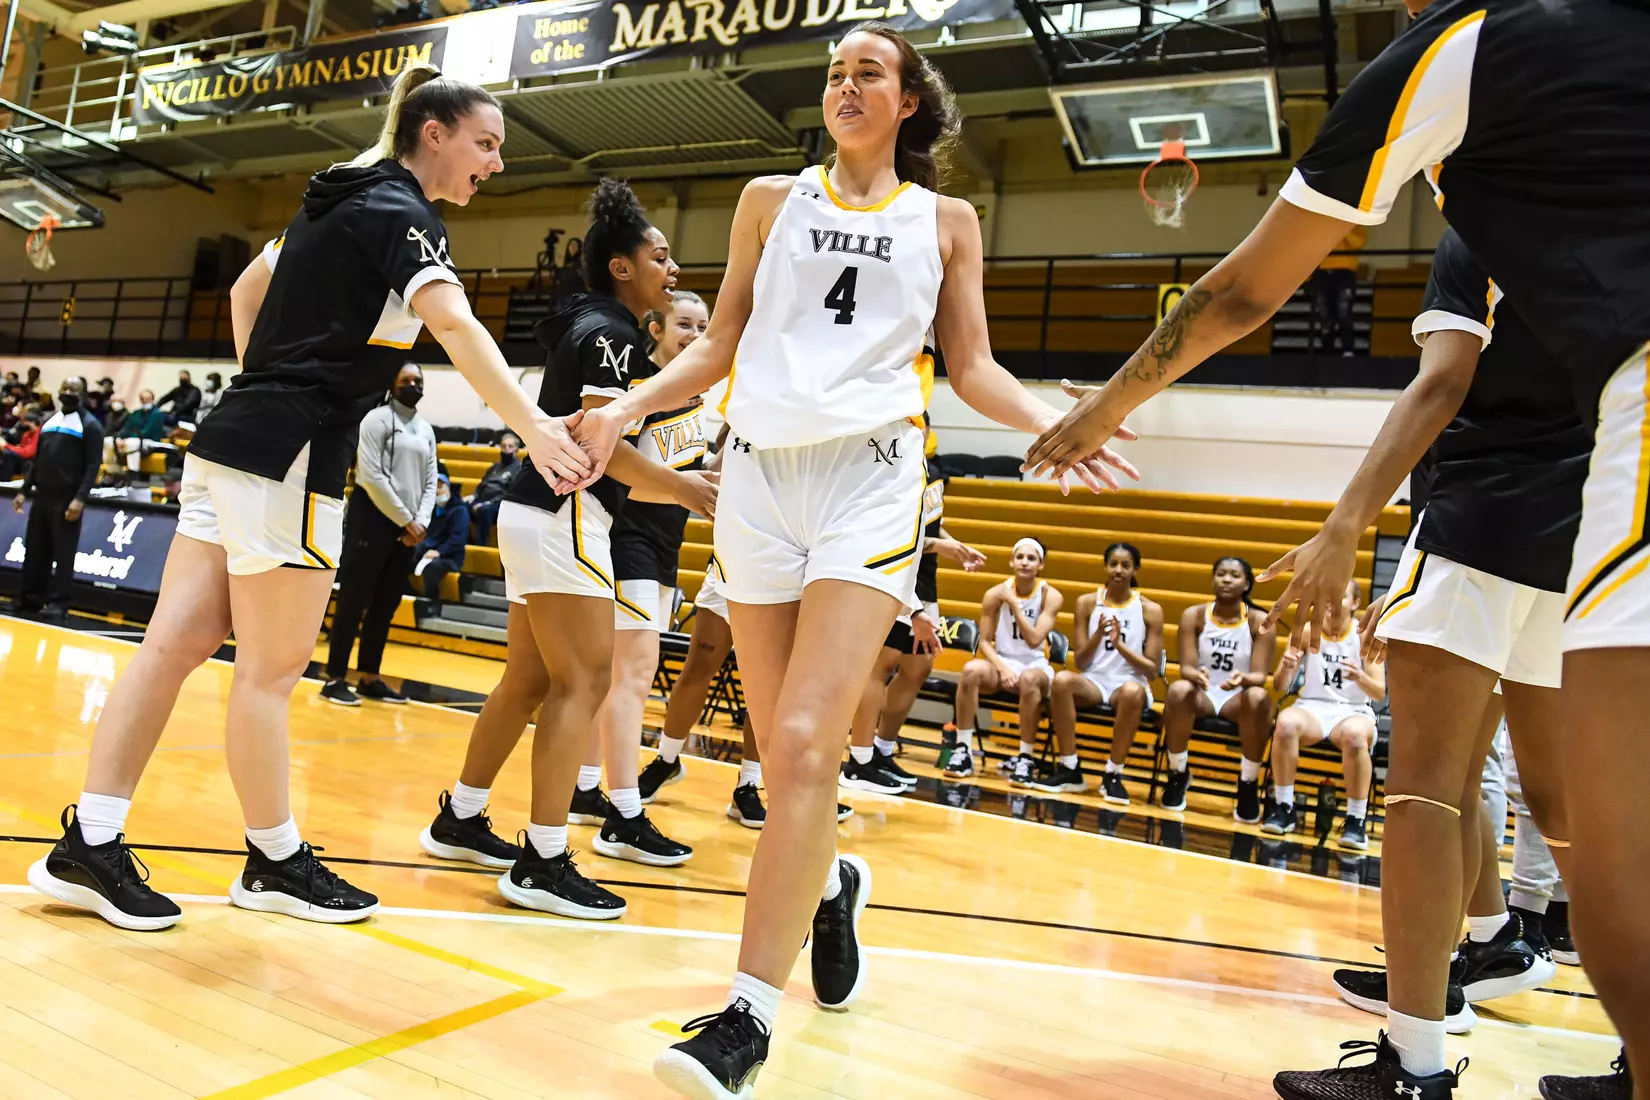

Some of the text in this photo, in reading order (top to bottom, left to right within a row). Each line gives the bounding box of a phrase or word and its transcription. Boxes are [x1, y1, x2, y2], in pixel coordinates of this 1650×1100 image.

[533, 16, 590, 40] Home
[530, 39, 586, 65] of the
[142, 41, 434, 110] PUCILLO GYMNASIUM
[809, 228, 893, 263] VILLE
[824, 266, 858, 325] 4
[1211, 651, 1235, 672] 35
[1323, 668, 1343, 690] 14
